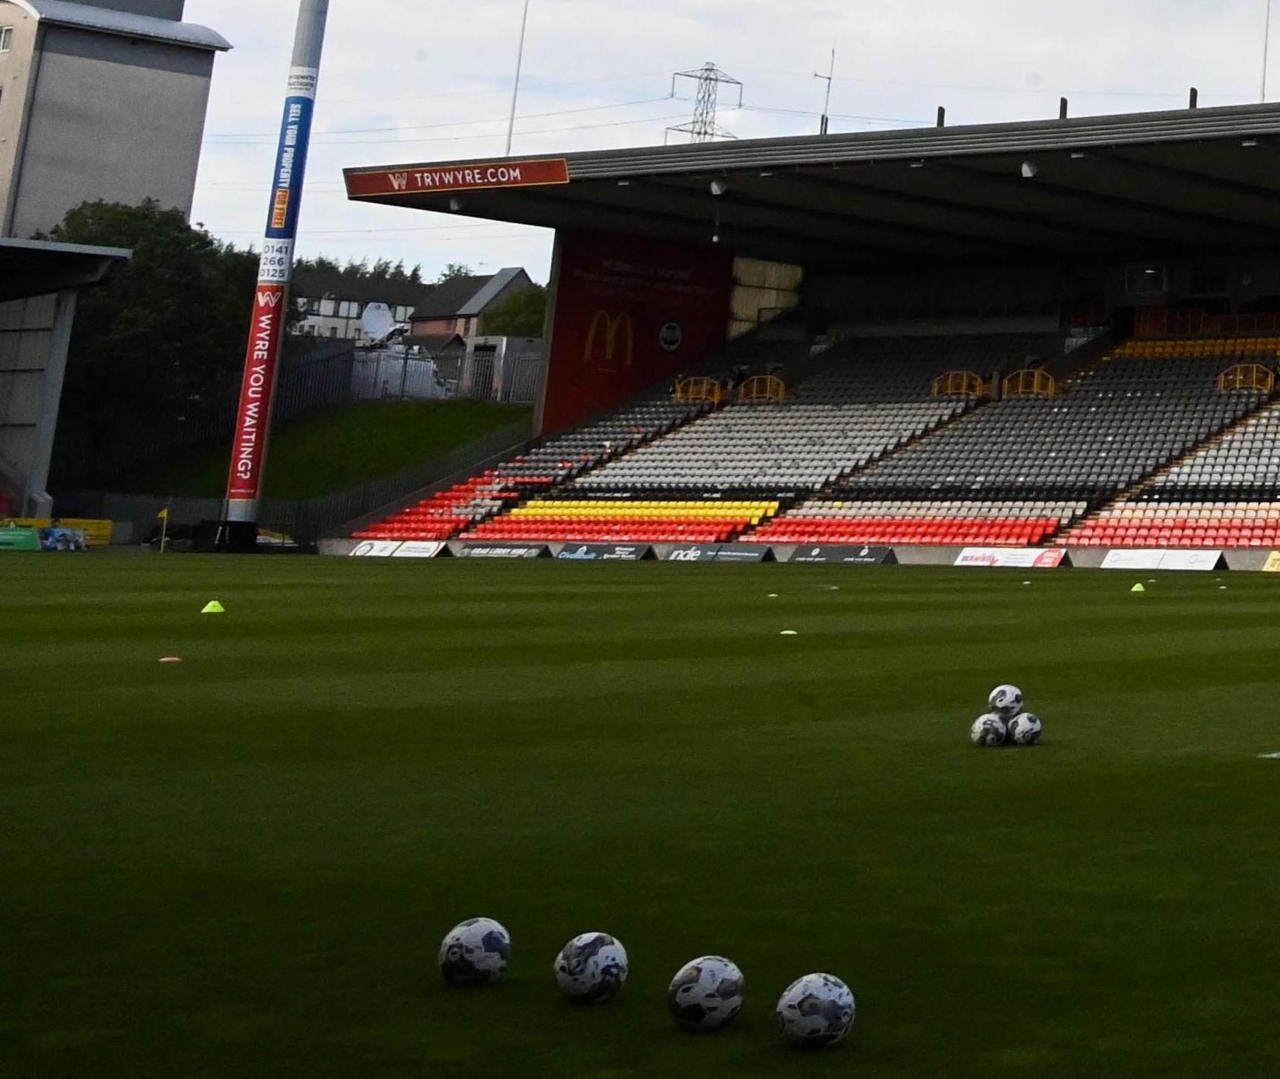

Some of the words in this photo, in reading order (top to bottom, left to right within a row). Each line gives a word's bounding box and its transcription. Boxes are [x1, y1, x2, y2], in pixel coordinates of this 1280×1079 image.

[284, 124, 299, 146] YOUR
[415, 167, 522, 187] TRYWYRE.COM
[264, 245, 289, 255] 0141
[262, 257, 285, 267] 266
[253, 314, 273, 360] WYRE
[247, 365, 266, 398] YOU
[236, 402, 259, 480] WAITING?
